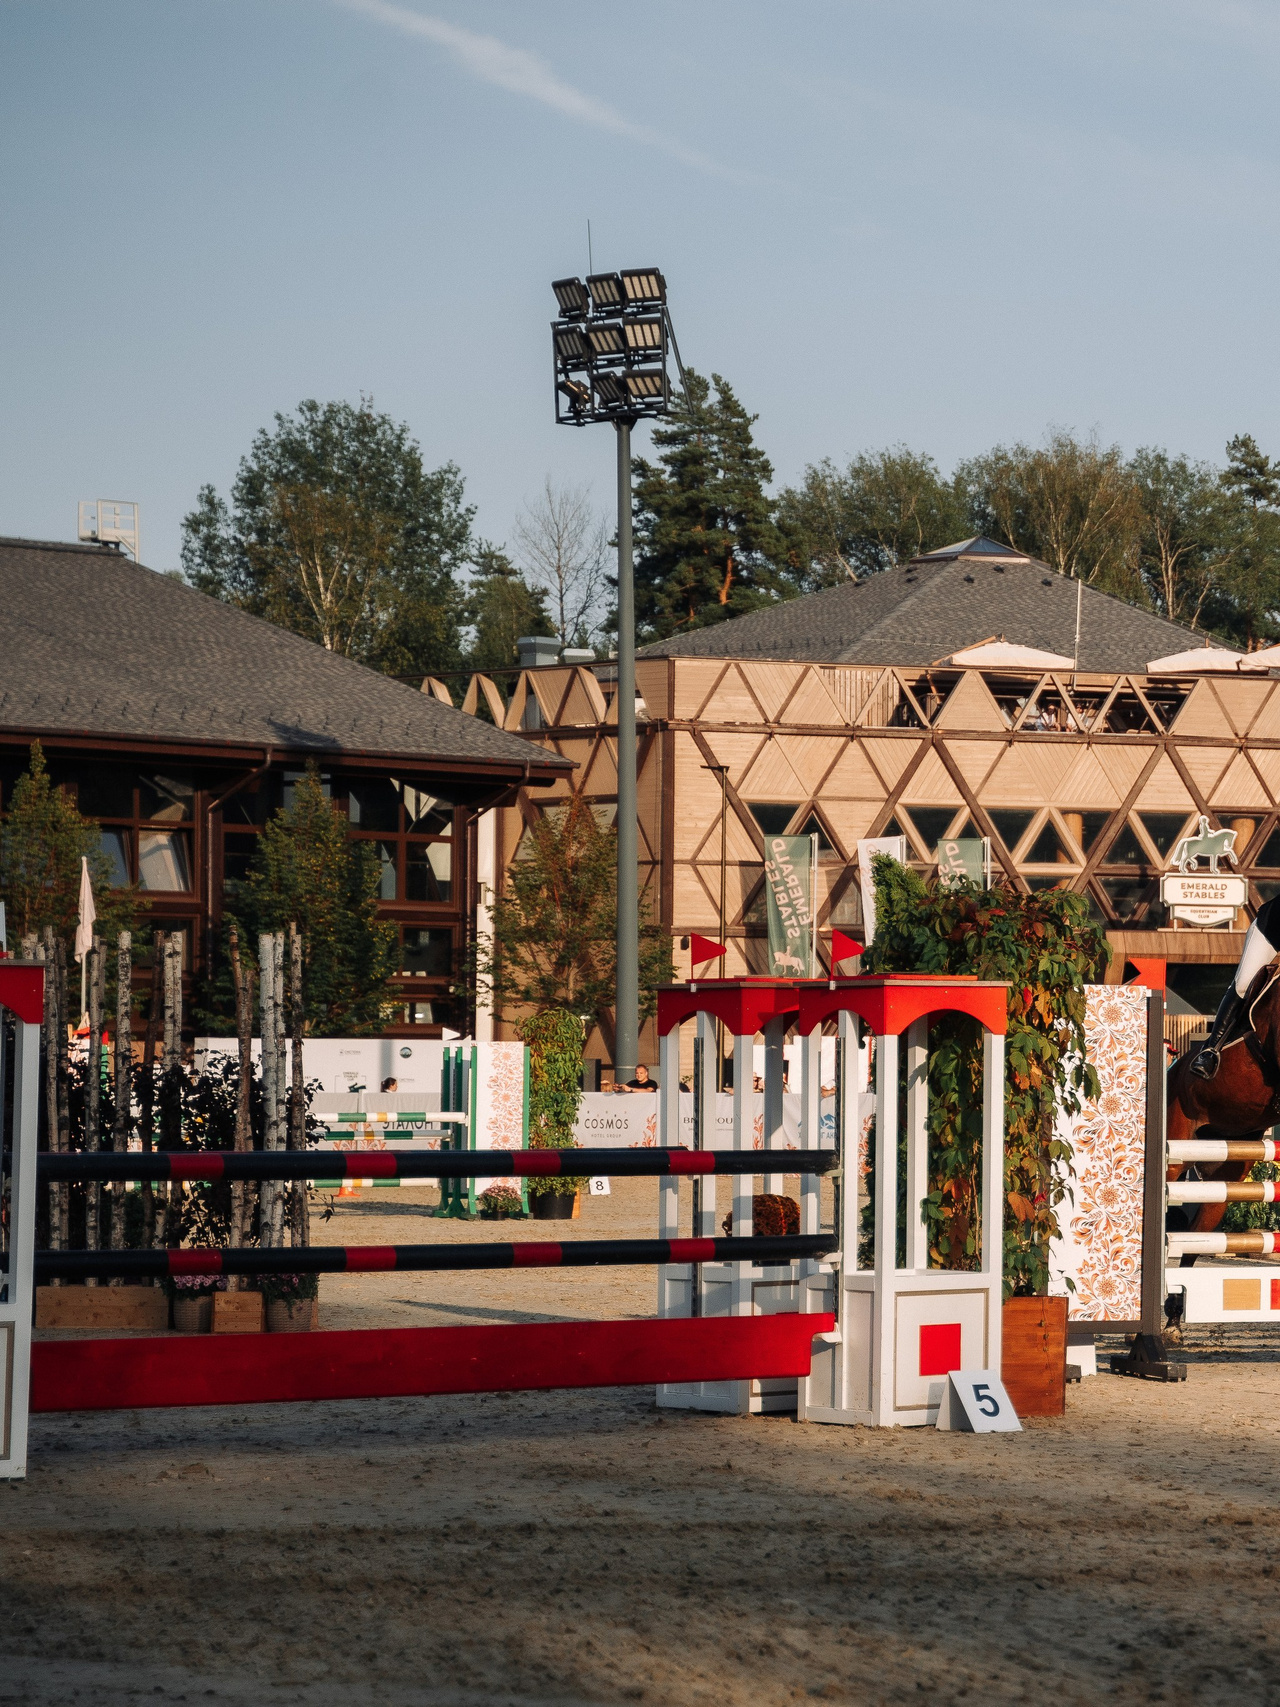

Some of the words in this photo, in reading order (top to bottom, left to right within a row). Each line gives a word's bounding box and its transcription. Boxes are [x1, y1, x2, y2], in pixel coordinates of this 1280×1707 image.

[1180, 883, 1228, 891] EMERALD
[1182, 891, 1225, 899] STABLES
[584, 1118, 629, 1129] COSMOS
[595, 1181, 604, 1191] 8
[971, 1383, 1000, 1417] 5
